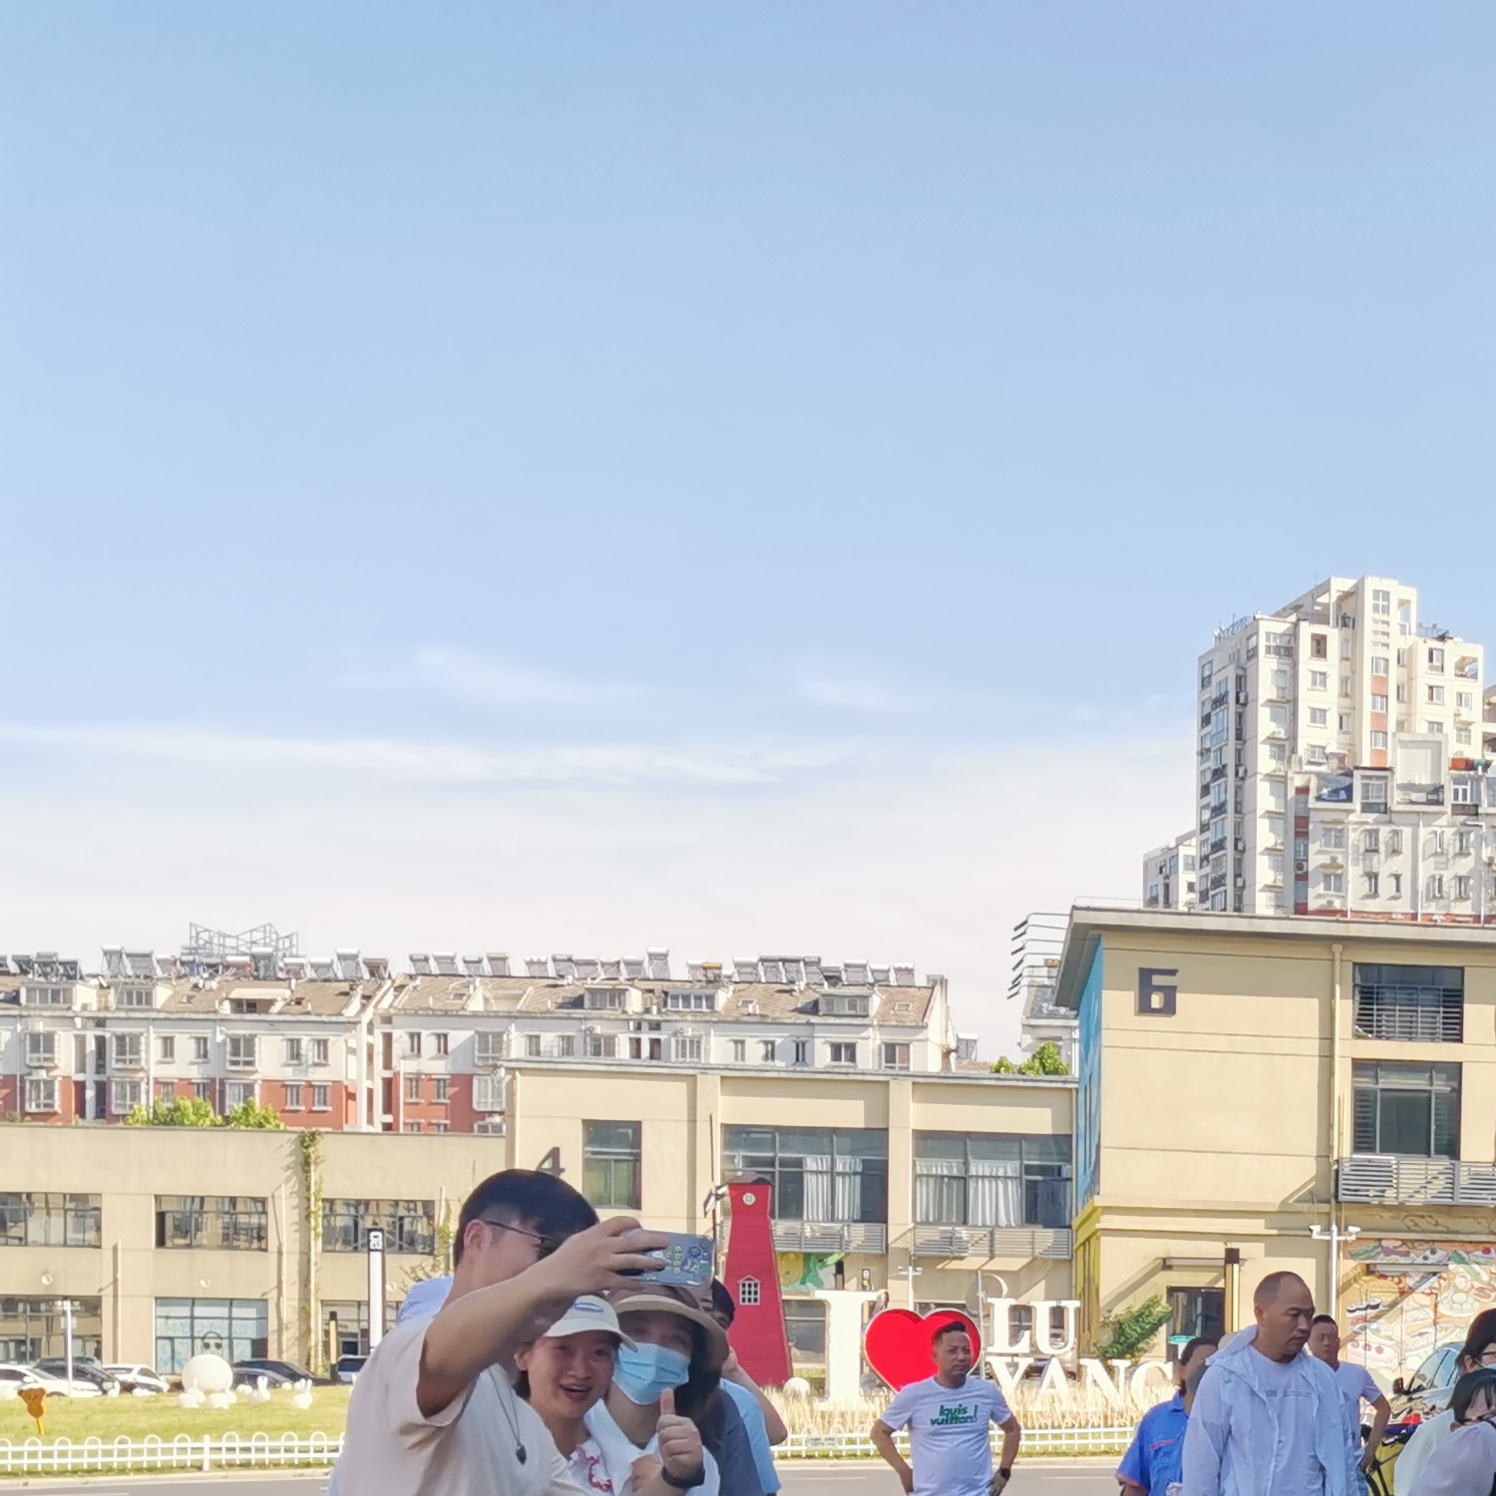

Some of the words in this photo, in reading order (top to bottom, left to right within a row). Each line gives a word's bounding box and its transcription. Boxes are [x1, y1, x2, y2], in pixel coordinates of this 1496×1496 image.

[1138, 966, 1179, 1015] 6
[814, 1289, 888, 1404] I
[987, 1297, 1081, 1354] LU
